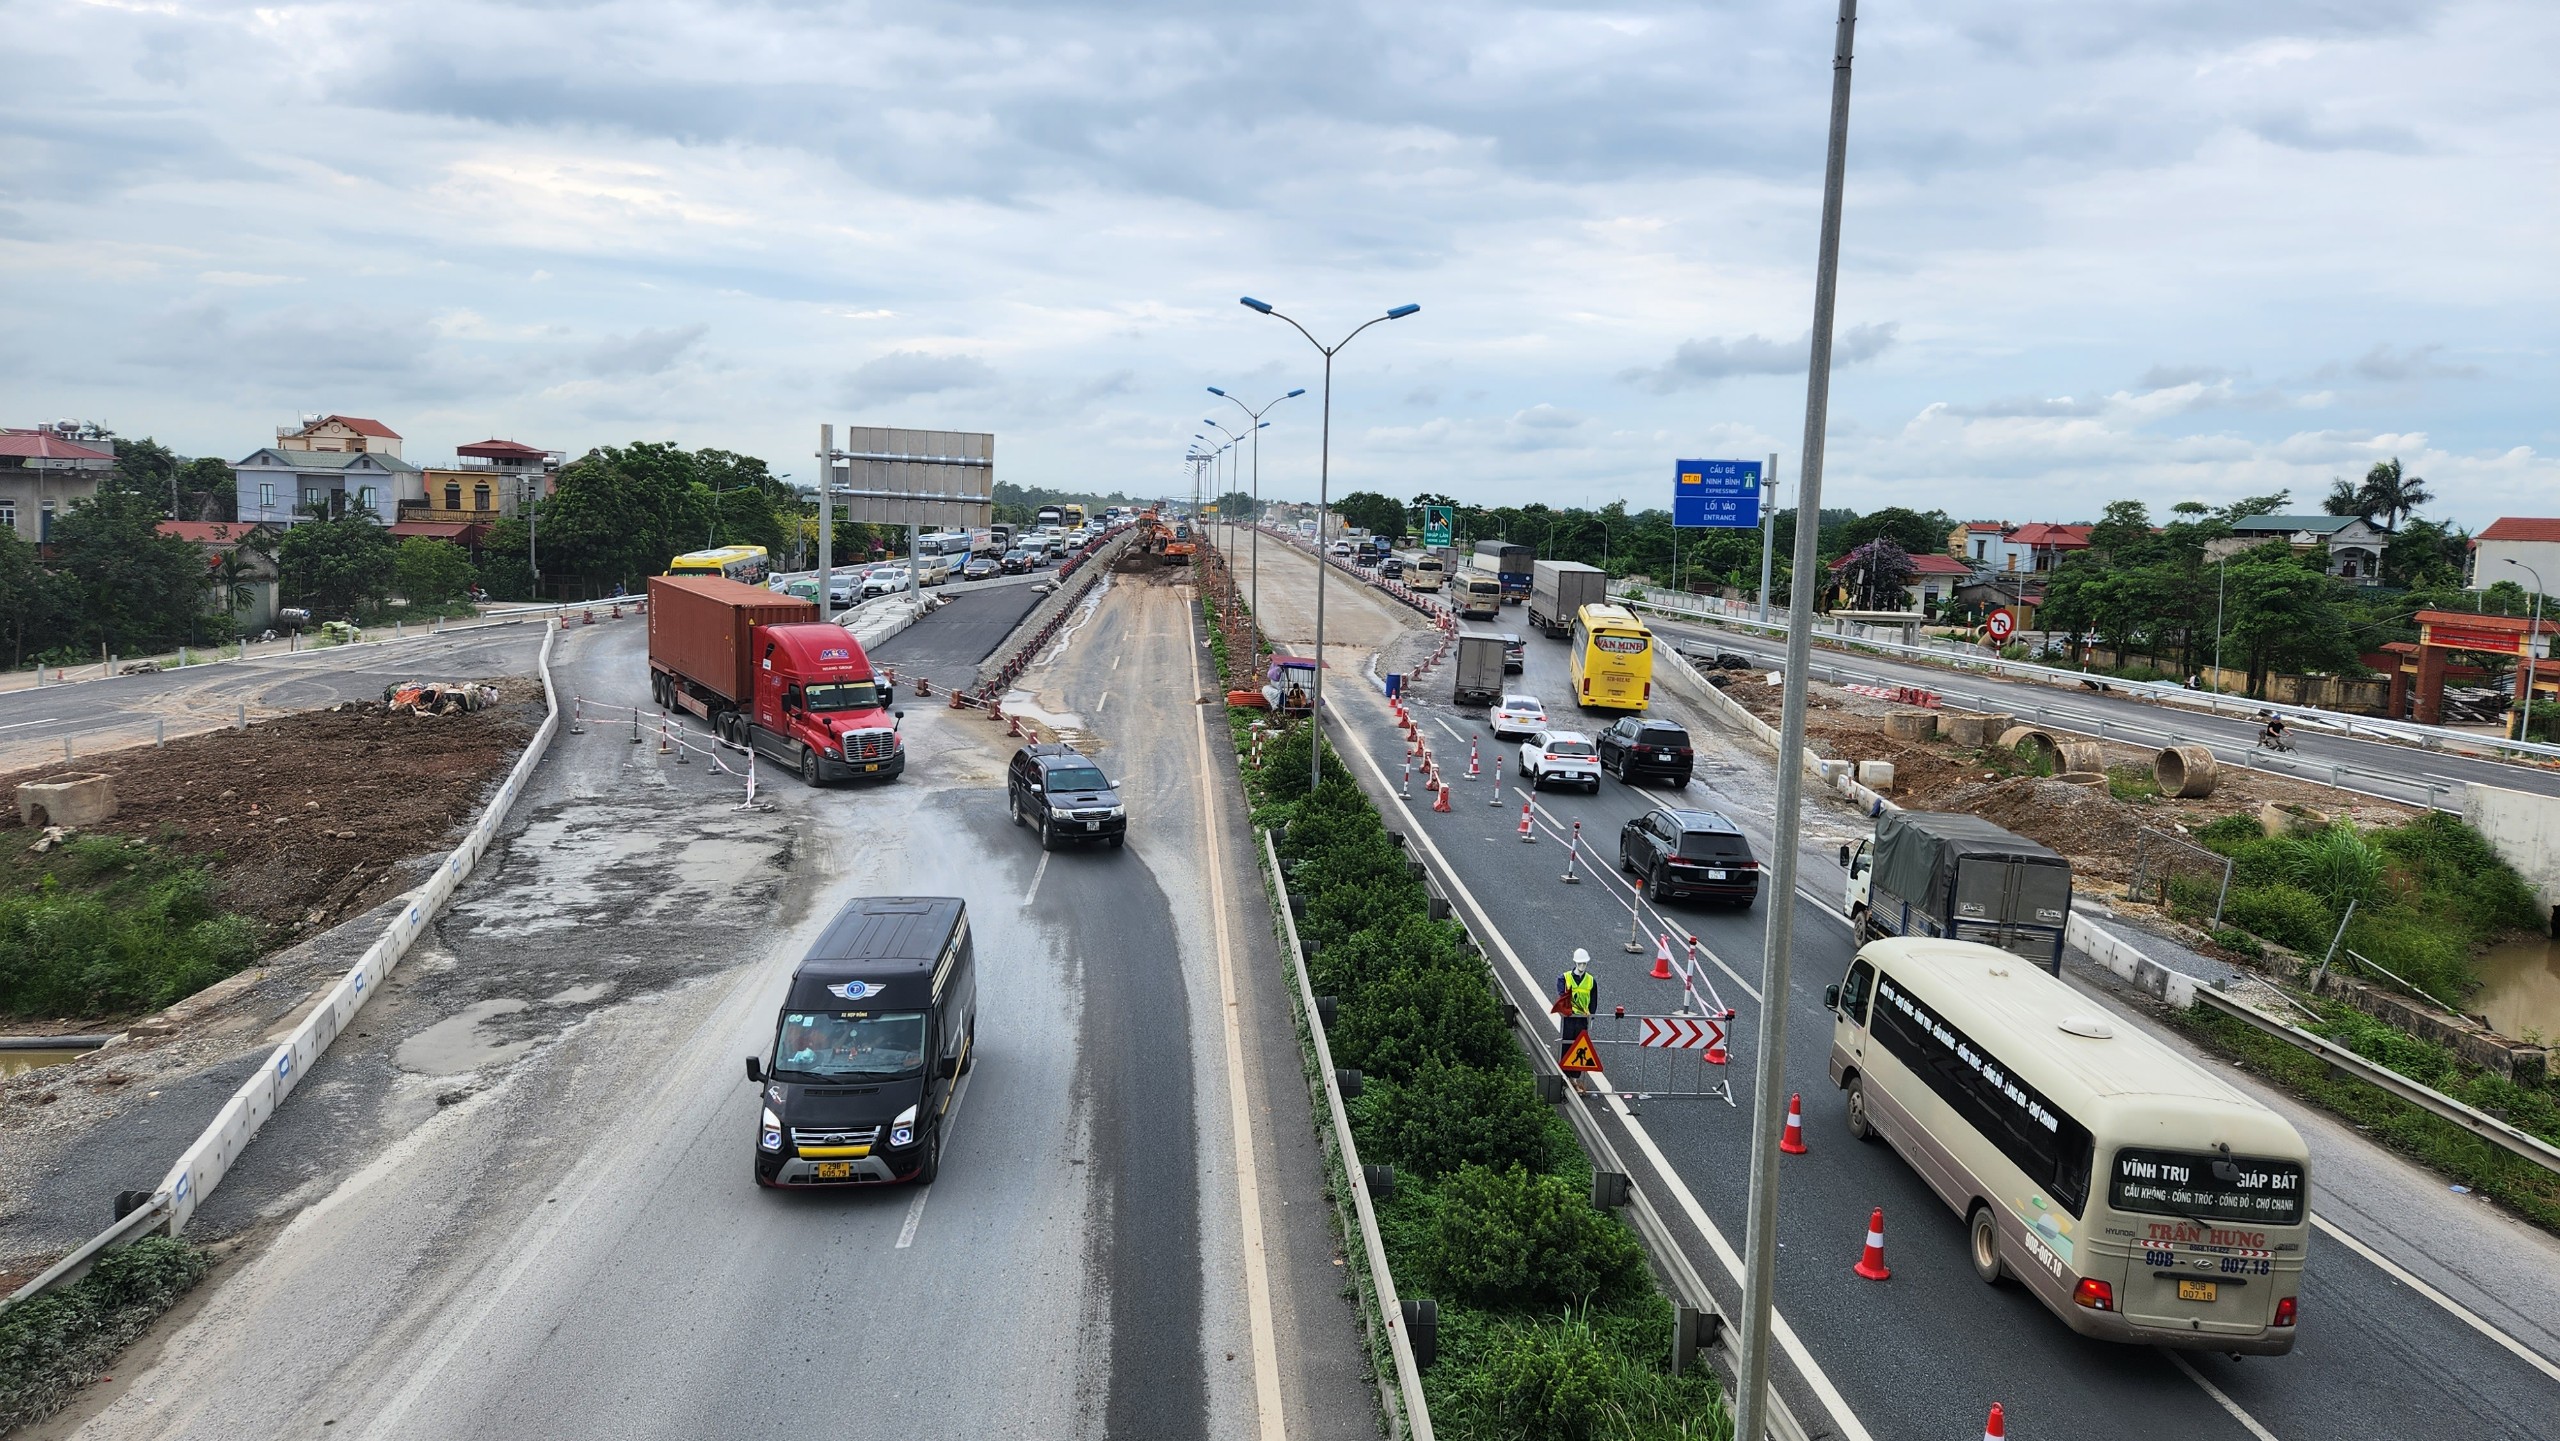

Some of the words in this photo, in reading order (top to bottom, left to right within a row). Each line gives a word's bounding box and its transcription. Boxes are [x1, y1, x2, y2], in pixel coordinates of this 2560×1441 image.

[1724, 477, 1740, 486] BÌNH
[1722, 501, 1736, 510] VÀO
[1618, 641, 1642, 650] MINH
[2040, 1109, 2058, 1133] CHANH
[2122, 1158, 2157, 1179] VĨNH
[2161, 1165, 2189, 1185] TRỤ
[2236, 1170, 2268, 1188] GIÁP
[2272, 1171, 2298, 1189] BÁT
[2124, 1182, 2140, 1197] CẦU
[2141, 1186, 2166, 1200] KHÔNG
[2172, 1188, 2191, 1203] CỐNG
[2194, 1191, 2214, 1205] TRÓC
[2220, 1192, 2238, 1207] CỐNG
[2240, 1193, 2250, 1208] ĐỎ
[2256, 1197, 2271, 1212] CHỢ
[2272, 1199, 2294, 1211] CHANH
[2106, 1228, 2135, 1237] HYUNDAI
[2148, 1222, 2201, 1242] TRẦN
[2209, 1229, 2265, 1248] HƯNG
[2025, 1232, 2062, 1277] 90B-007.18
[2146, 1250, 2174, 1267] 90B
[2221, 1258, 2270, 1275] 007.18
[2190, 1281, 2206, 1290] 90B
[2183, 1290, 2212, 1300] 007.18
